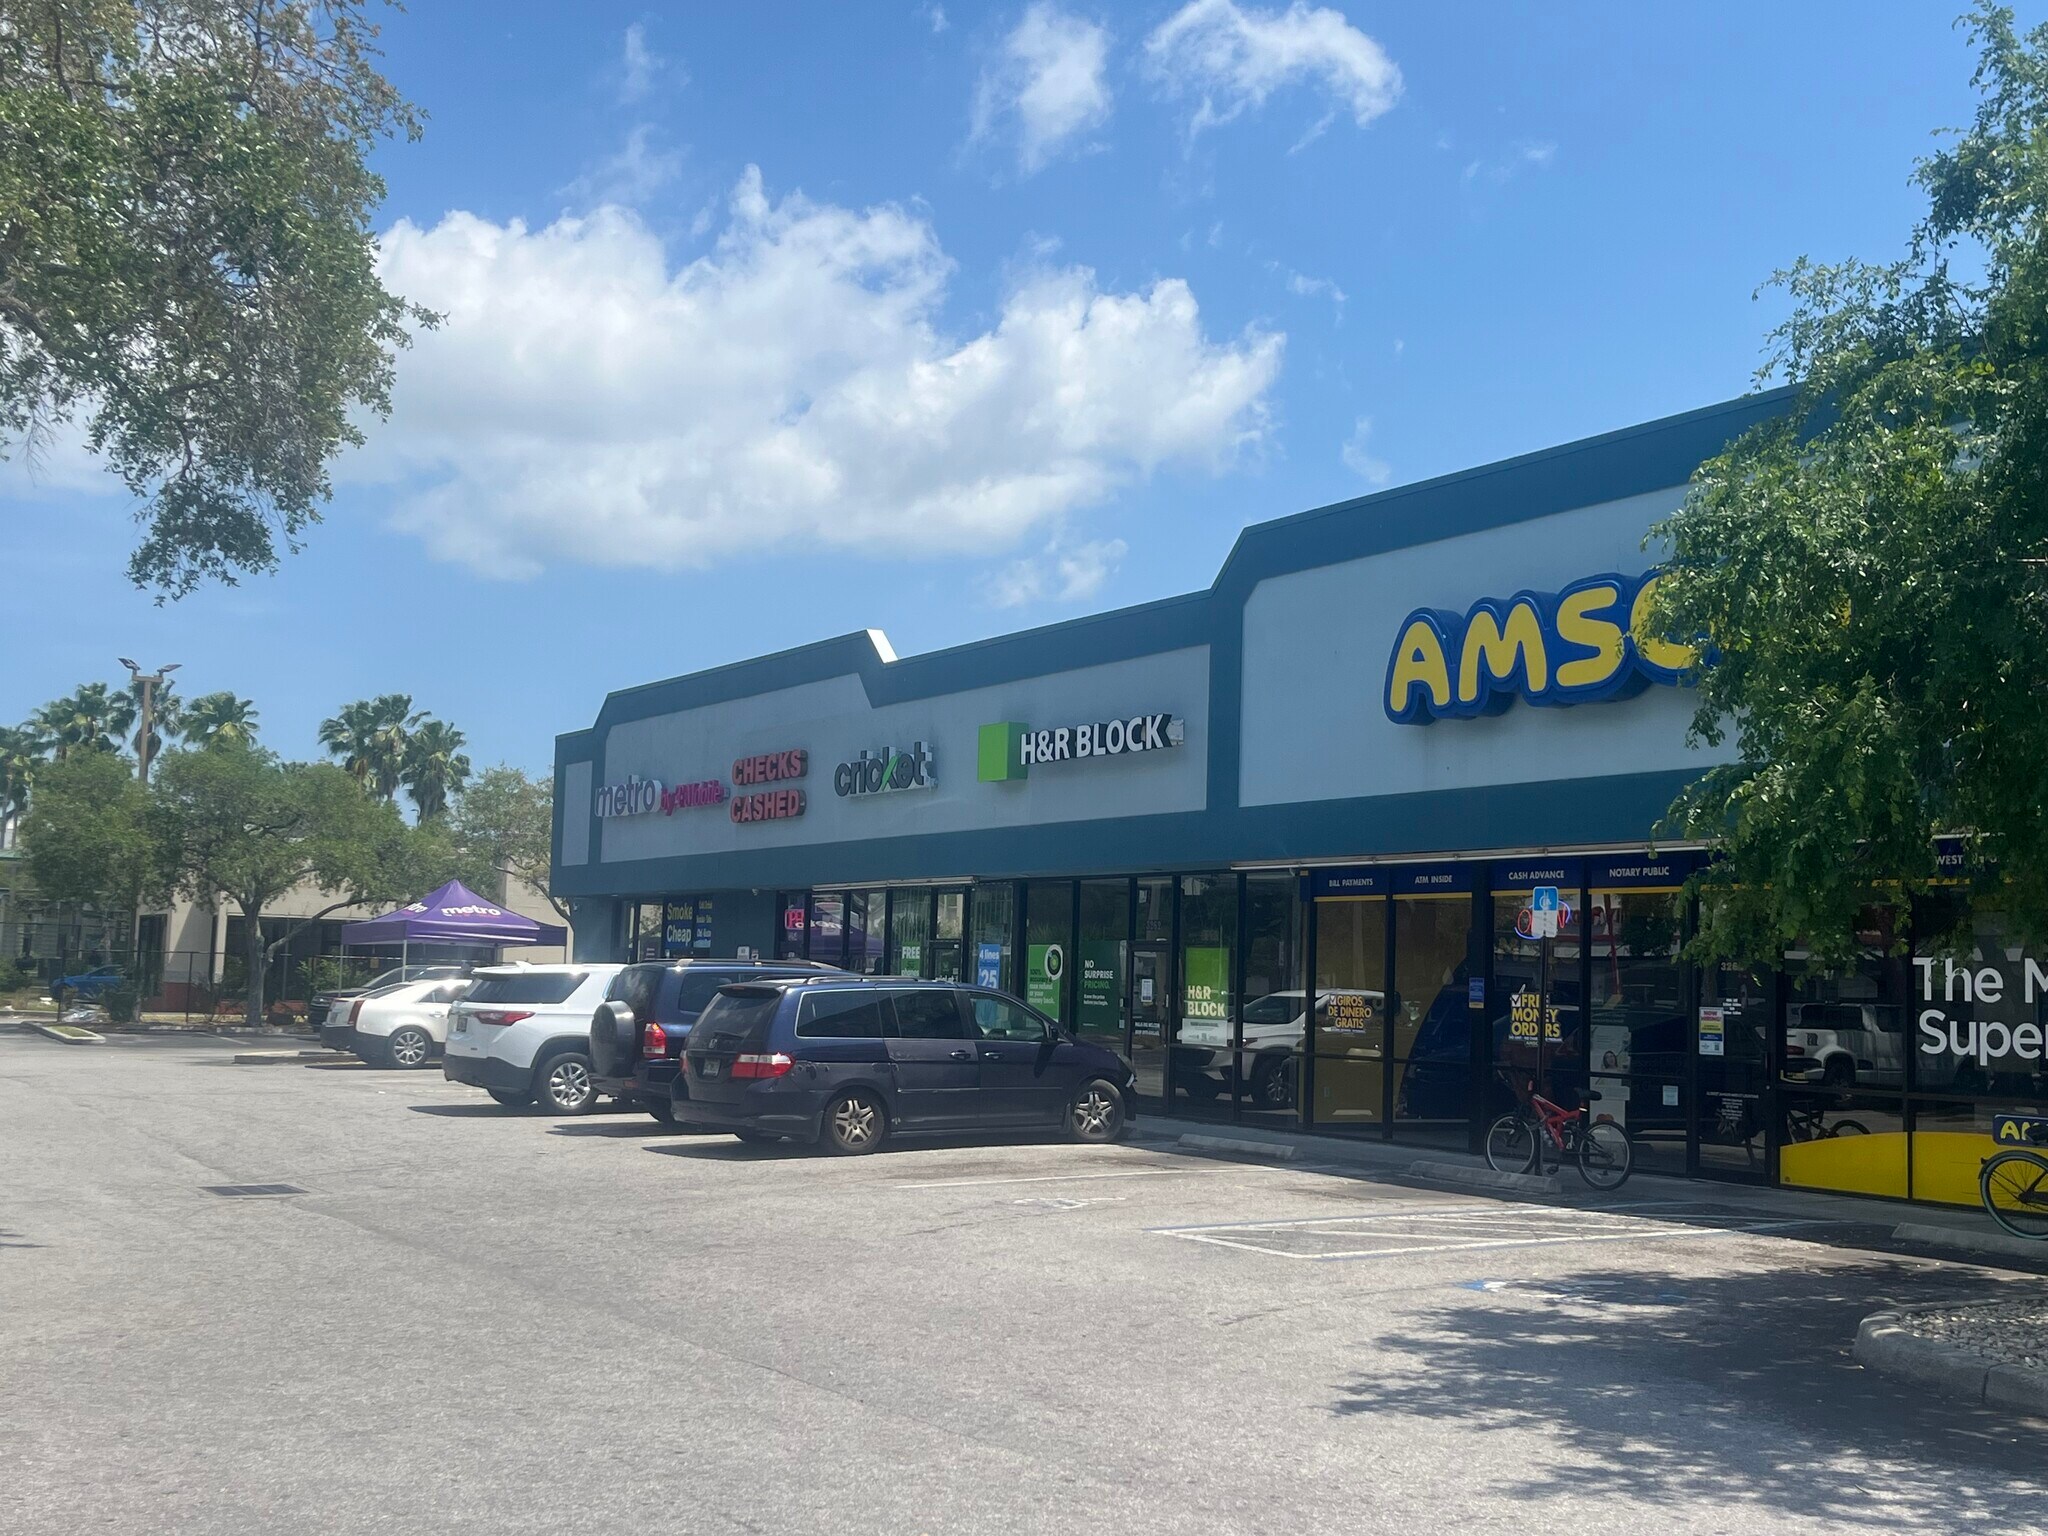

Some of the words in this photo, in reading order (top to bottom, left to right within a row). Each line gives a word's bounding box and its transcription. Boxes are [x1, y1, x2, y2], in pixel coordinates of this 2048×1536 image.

[1386, 566, 1704, 718] AMSC
[1020, 727, 1071, 765] H&R
[1076, 714, 1166, 758] BLOCK
[732, 749, 803, 785] CHECKS
[834, 741, 926, 797] cricket
[595, 775, 659, 816] metro
[731, 789, 803, 823] CASHED
[1414, 875, 1429, 884] ATM
[1431, 874, 1453, 883] INSIDE
[1508, 871, 1528, 880] CASH
[1529, 870, 1565, 879] ADVANCE
[1609, 867, 1641, 878] NOTARY
[1642, 866, 1670, 876] PUBLIC
[1328, 879, 1340, 887] BILL
[1342, 878, 1374, 887] PAYMENTS
[441, 904, 502, 917] metro
[667, 902, 693, 920] Smoke
[1517, 903, 1568, 933] ON
[666, 924, 692, 947] Cheap
[902, 946, 920, 959] FREE
[979, 948, 984, 959] 4
[1084, 959, 1095, 968] NO
[1720, 962, 1744, 971] 326
[1084, 969, 1114, 979] SURPRISE
[1912, 957, 2004, 1003] The
[1187, 985, 1211, 1000] H&R
[1337, 995, 1364, 1006] GIROS
[1521, 994, 1540, 1008] FR
[1187, 1001, 1225, 1017] BLOCK
[1328, 1006, 1338, 1016] DE
[1340, 1006, 1373, 1018] DINERO
[1511, 1008, 1559, 1023] MONY
[1335, 1017, 1365, 1028] GRATIS
[1511, 1022, 1560, 1037] ORDRS
[1919, 1009, 2048, 1067] Supe
